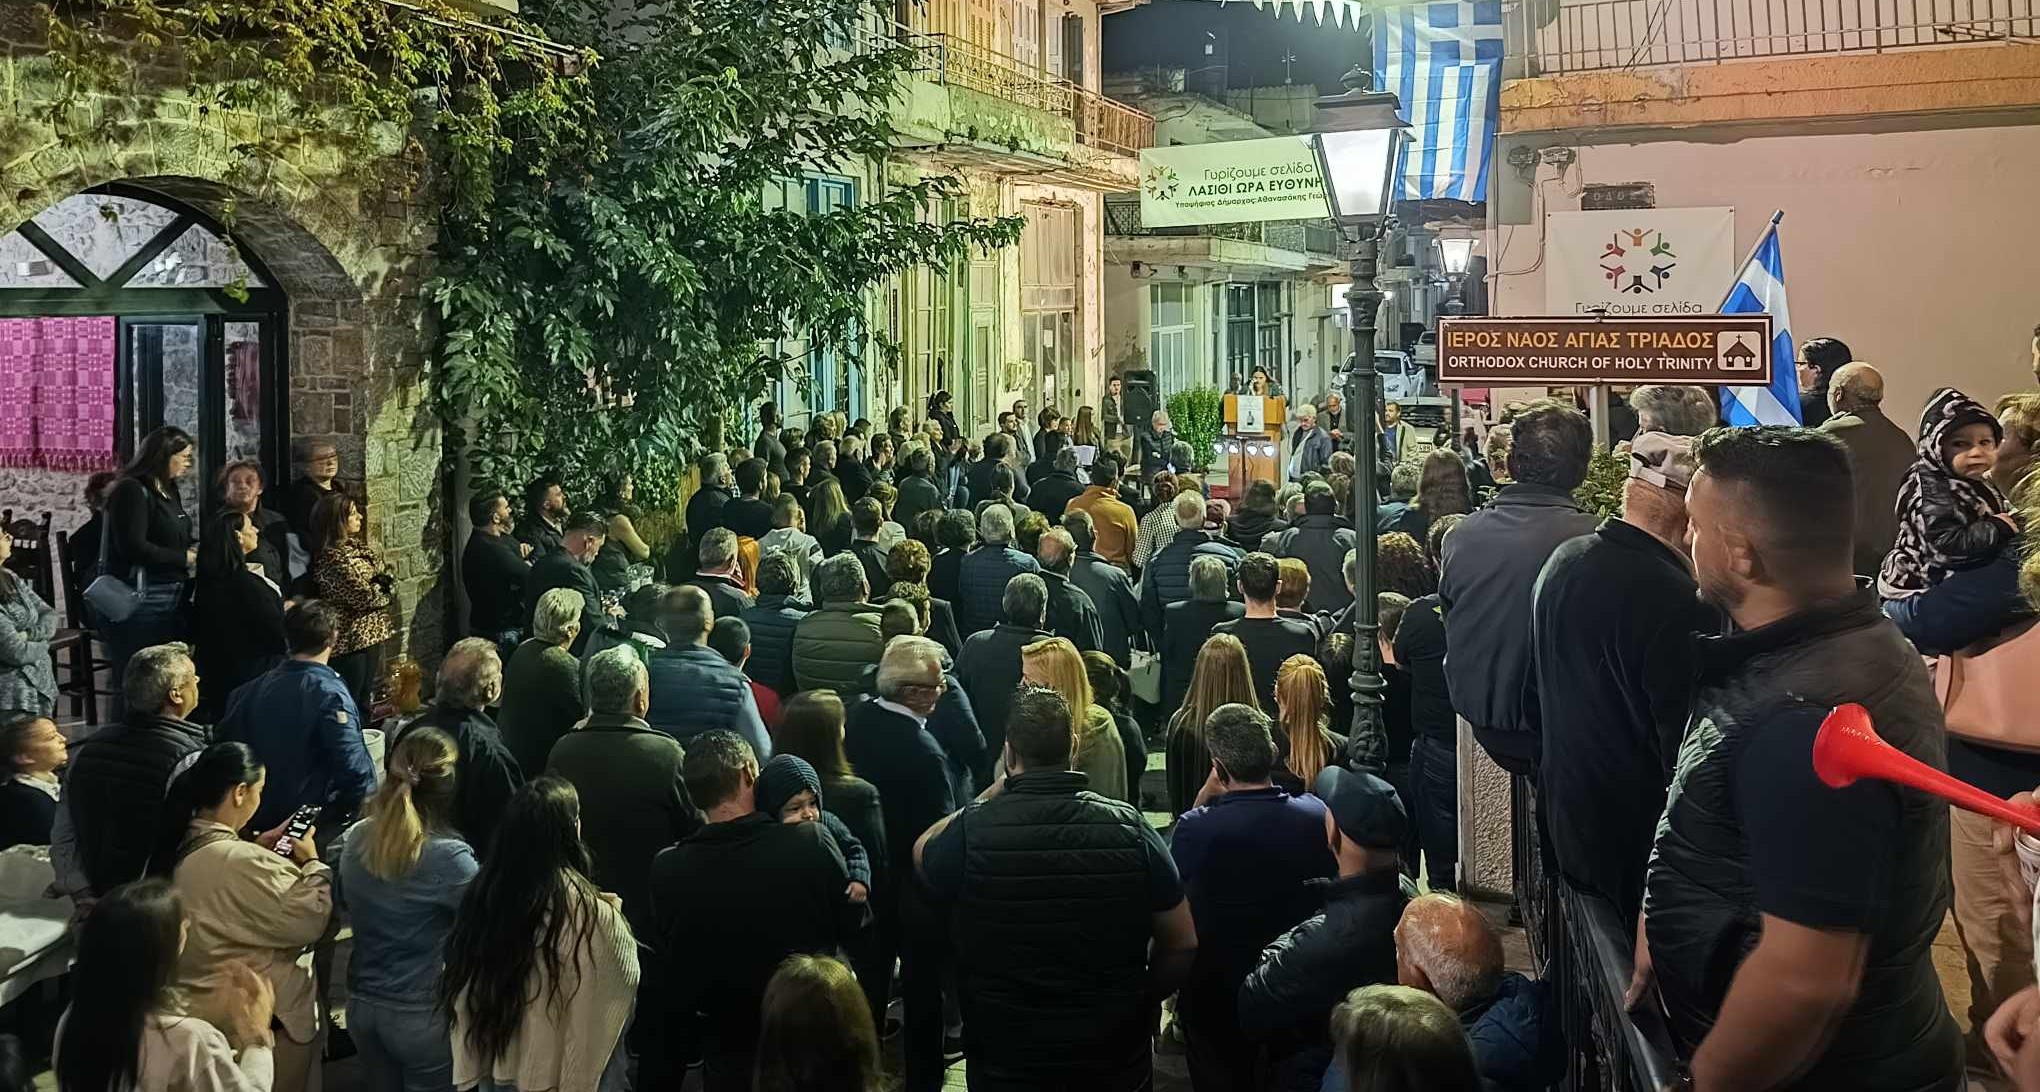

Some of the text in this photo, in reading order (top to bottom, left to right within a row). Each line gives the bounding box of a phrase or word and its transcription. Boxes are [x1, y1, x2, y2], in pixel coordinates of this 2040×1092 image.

[1204, 162, 1313, 181] Γυρίζουμε σελίδα
[1188, 177, 1323, 196] ΛΑΣΙΘΙ ΩΡΑ ΕΥΘΥΝΗ
[1652, 301, 1702, 314] σελίδα
[1447, 332, 1714, 348] ΙΕΡΟΣ ΝΑΟΣ ΑΓΙΑΣ ΤΡΙΑΔΟΣ
[1448, 356, 1713, 370] ORTHODOX CHURCH OF HOLY TRINITY
